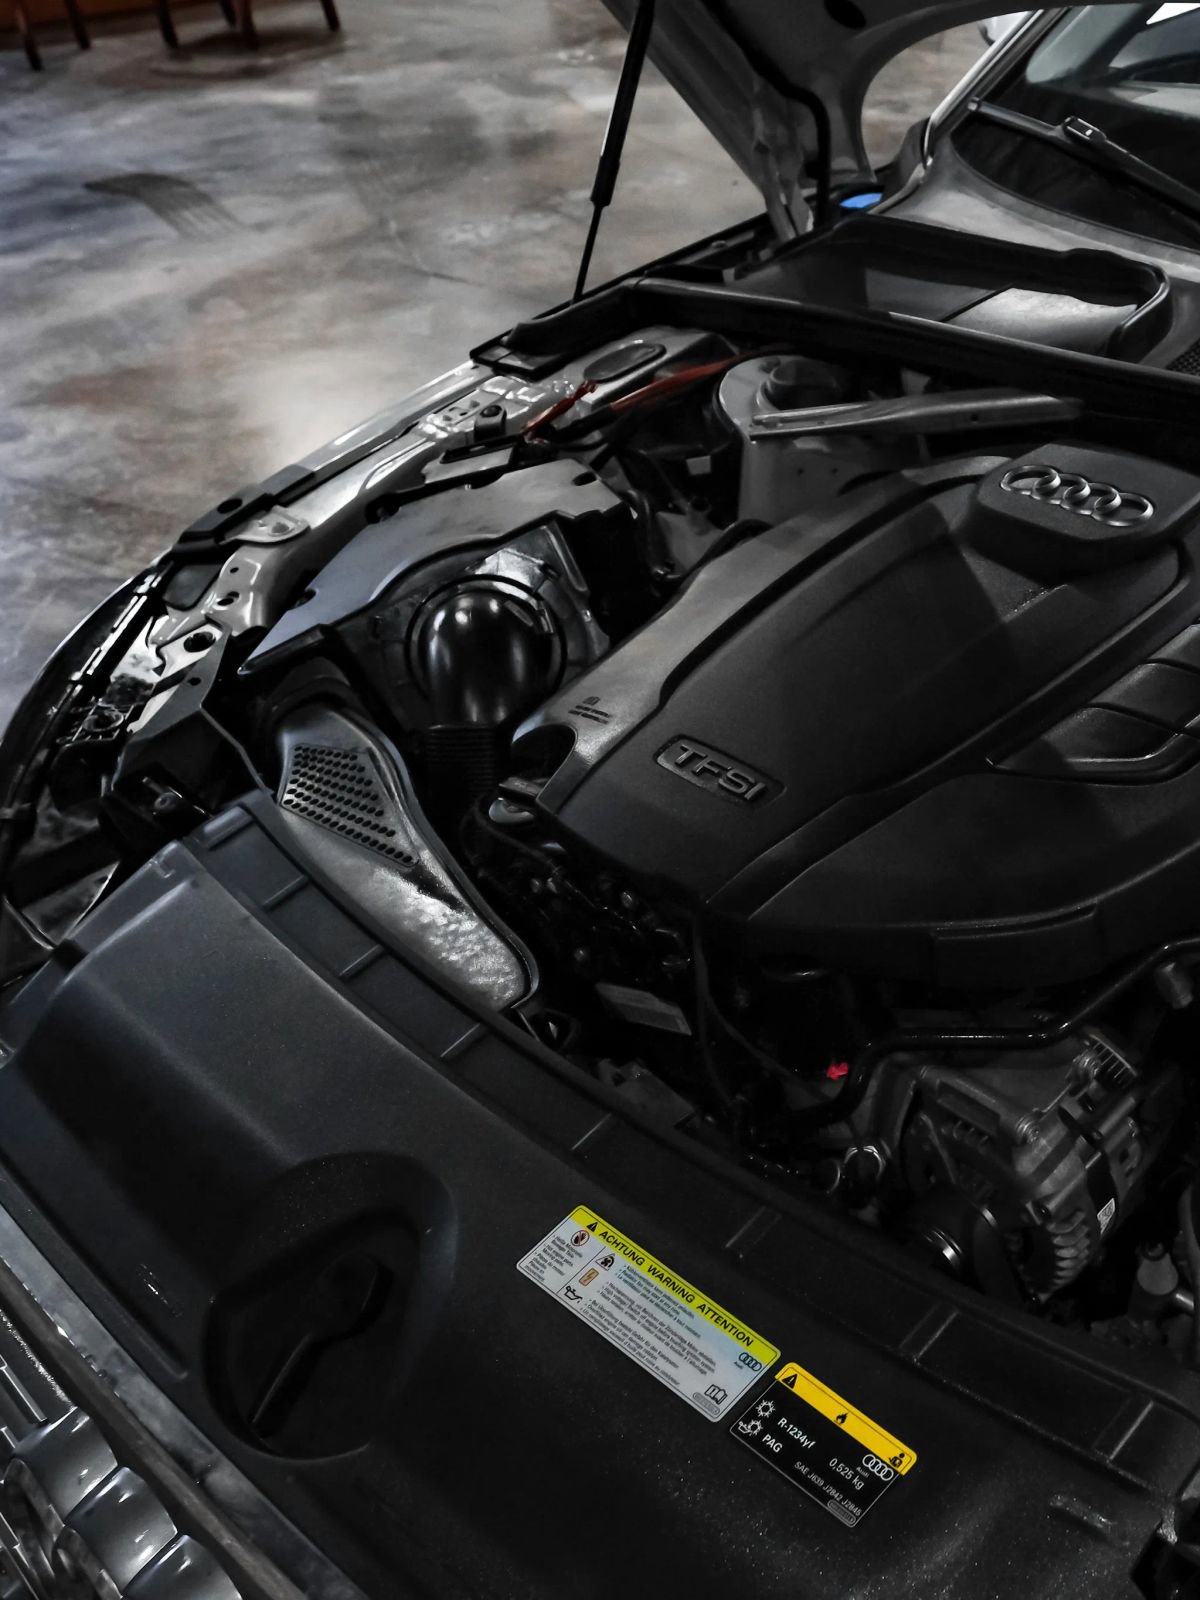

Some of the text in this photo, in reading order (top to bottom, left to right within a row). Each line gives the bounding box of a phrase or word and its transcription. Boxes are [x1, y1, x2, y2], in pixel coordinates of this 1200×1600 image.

[675, 744, 767, 801] TFSI
[598, 1231, 645, 1265] ACHTUNG
[647, 1264, 695, 1303] WARNING
[696, 1303, 753, 1346] ATTENTION
[761, 1433, 782, 1452] PAG
[777, 1416, 816, 1448] R-1234yf
[793, 1460, 809, 1475] SAE
[828, 1457, 864, 1490] 0,525 kg
